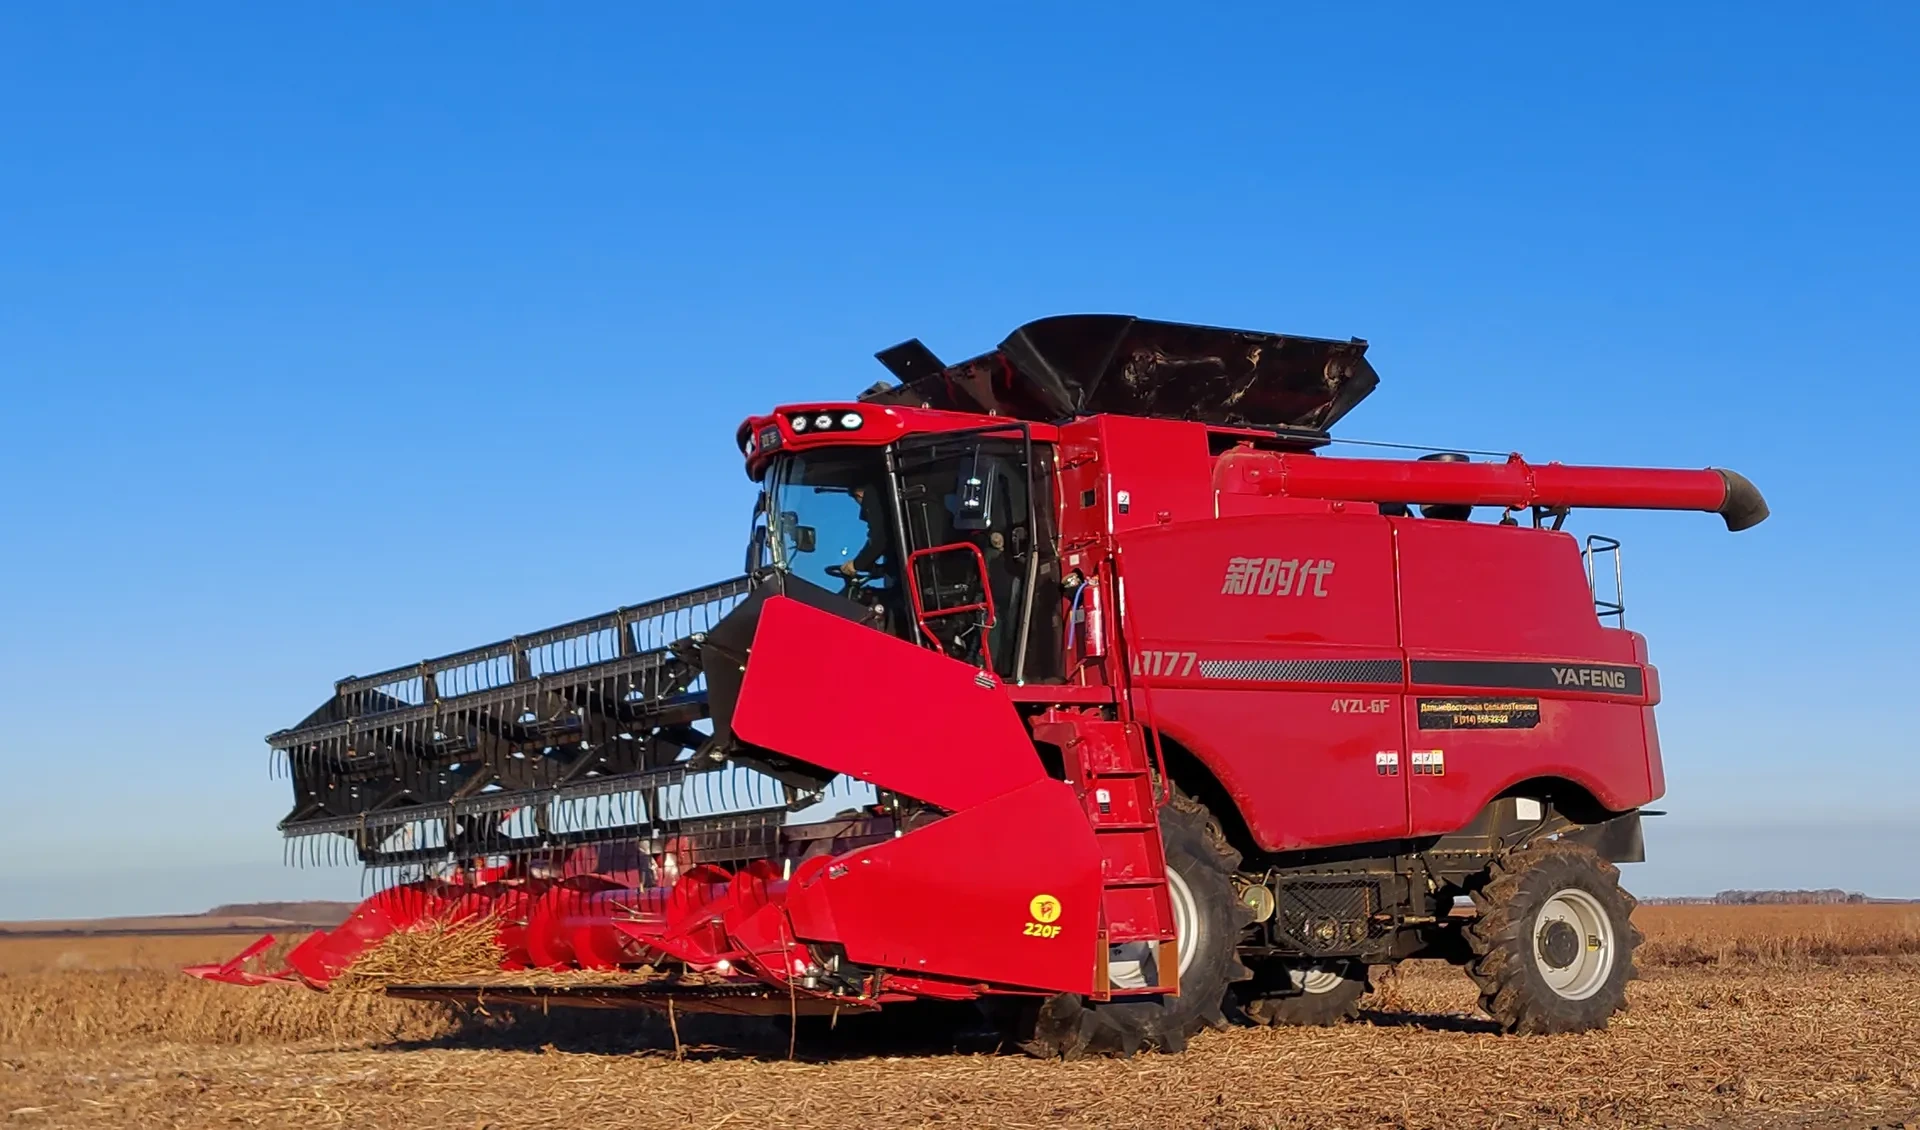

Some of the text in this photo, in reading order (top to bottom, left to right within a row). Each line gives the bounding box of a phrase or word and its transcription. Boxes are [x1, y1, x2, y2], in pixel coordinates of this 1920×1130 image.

[1221, 557, 1335, 597] 新时代
[1551, 667, 1626, 688] YAFENG
[1331, 699, 1390, 713] 4YZL-6F
[1023, 922, 1062, 938] 220F
